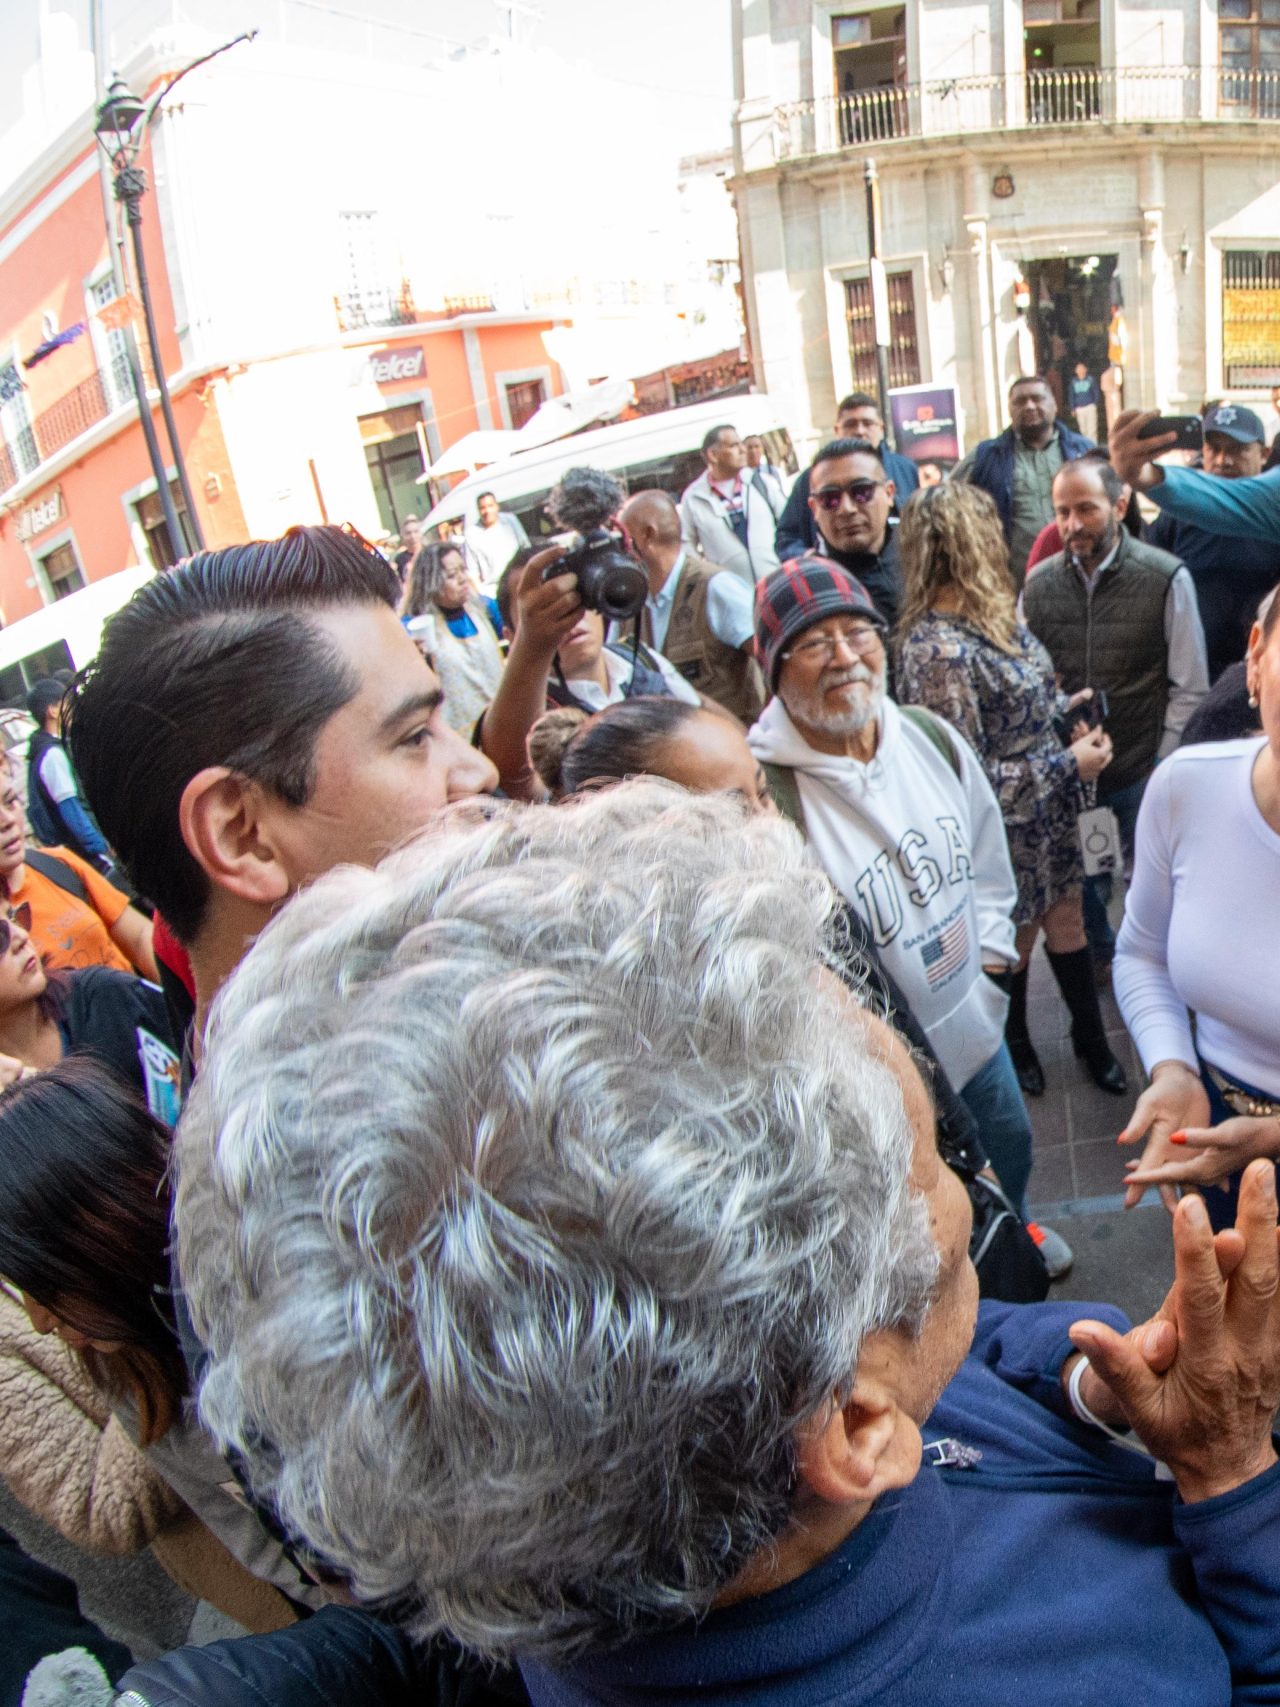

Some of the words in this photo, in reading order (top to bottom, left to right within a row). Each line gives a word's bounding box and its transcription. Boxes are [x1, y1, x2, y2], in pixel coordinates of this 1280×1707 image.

[372, 350, 424, 383] telcel
[855, 816, 975, 948] USA
[903, 933, 925, 950] SAN
